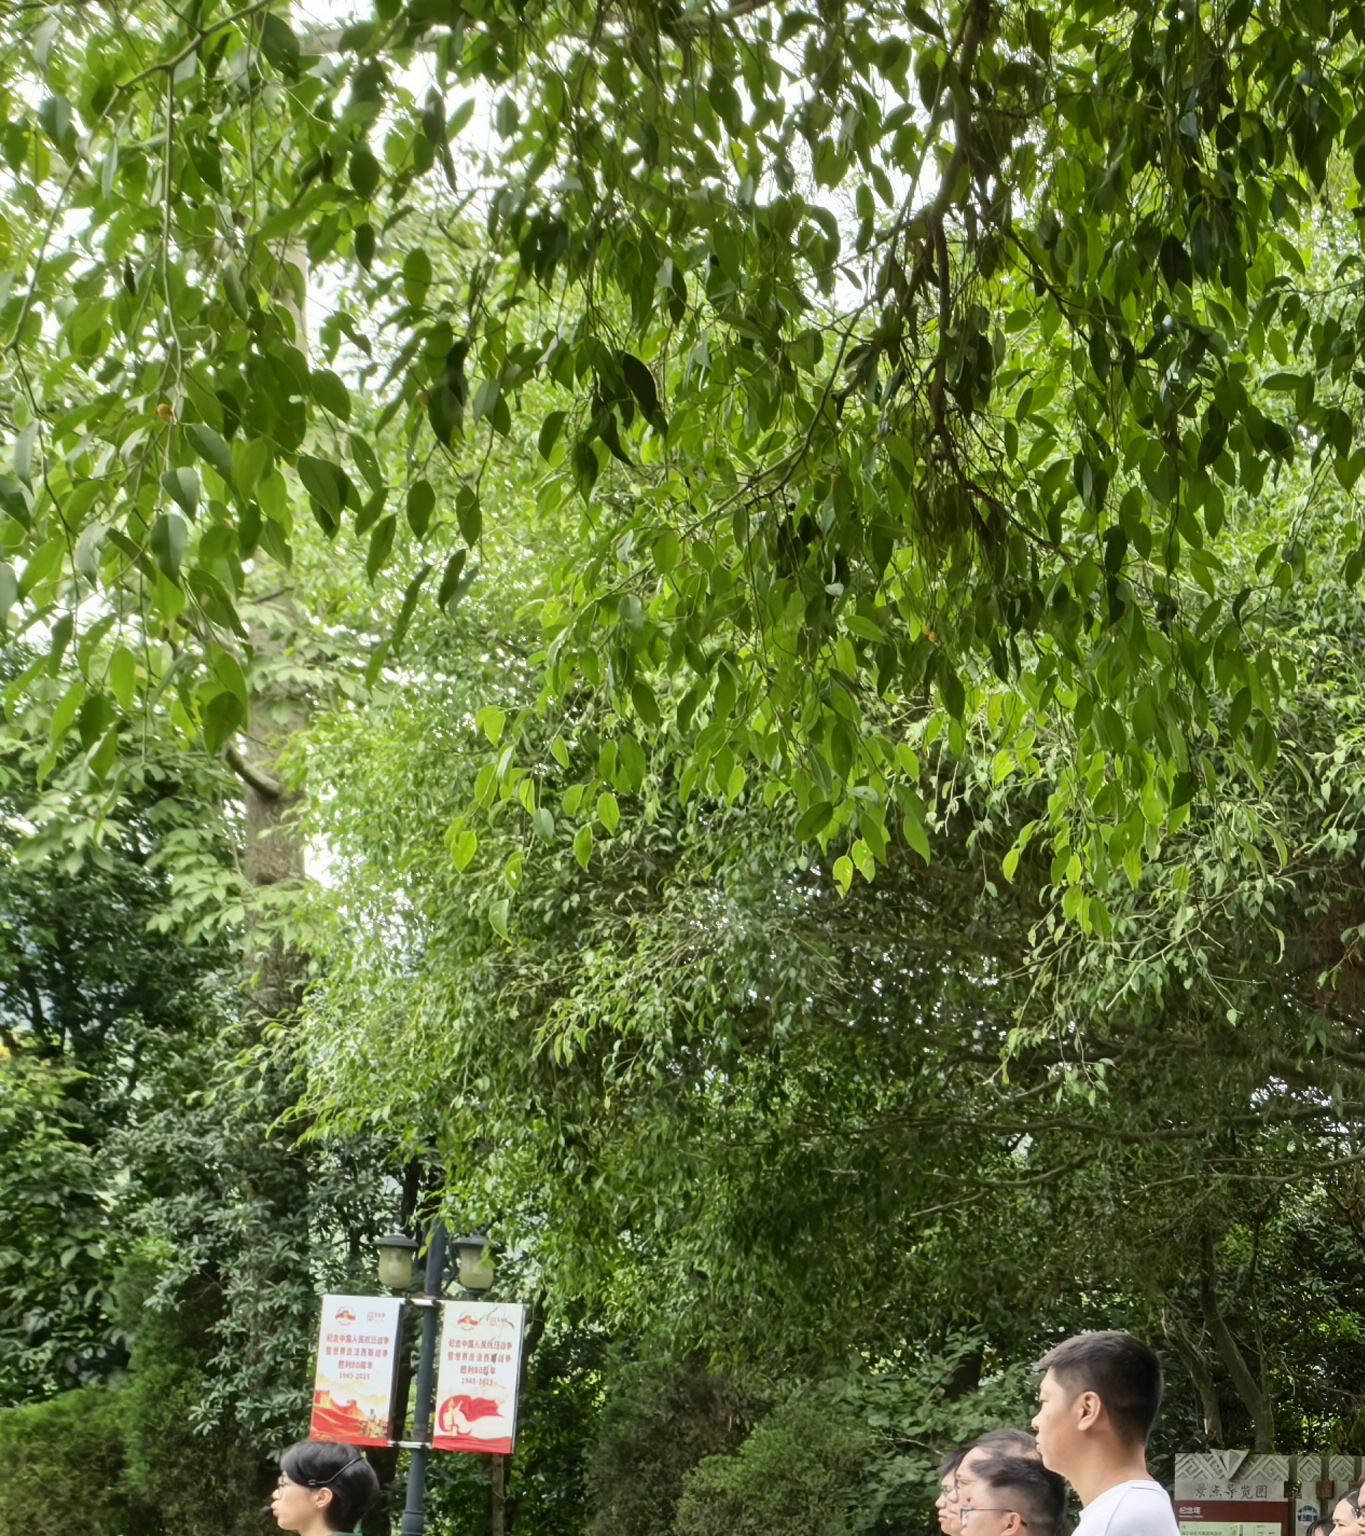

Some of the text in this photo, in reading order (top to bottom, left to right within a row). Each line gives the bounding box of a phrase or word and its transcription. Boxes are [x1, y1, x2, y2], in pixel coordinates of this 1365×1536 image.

[326, 1333, 390, 1345] 纪念中国人民抗日战争
[1195, 1484, 1268, 1499] 景点导览图
